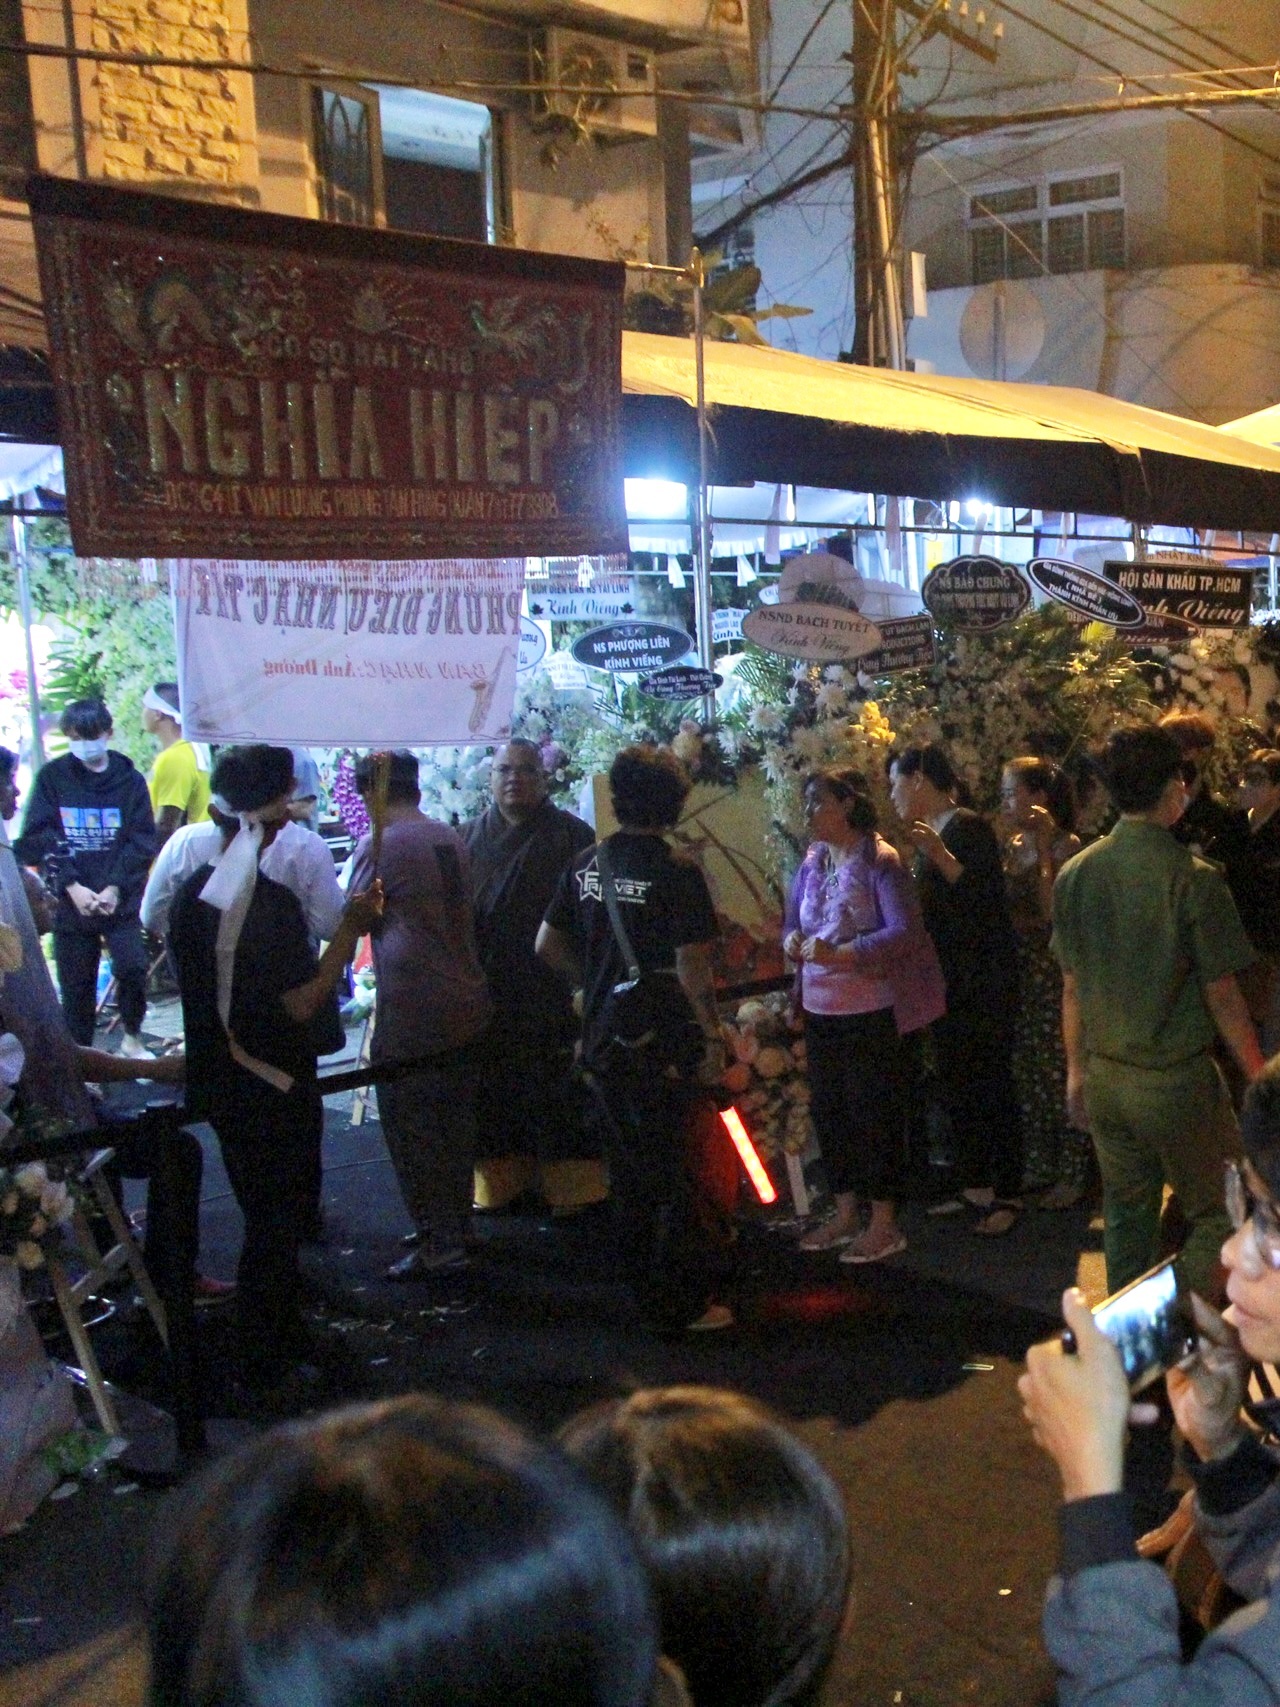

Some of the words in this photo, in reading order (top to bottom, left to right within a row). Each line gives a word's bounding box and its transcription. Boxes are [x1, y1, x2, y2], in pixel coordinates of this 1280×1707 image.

[593, 643, 607, 654] NS
[608, 638, 649, 656] PHƯỢNG
[650, 635, 671, 649] LIÊN
[604, 656, 631, 670] KÍNH
[632, 653, 663, 667] VIẾNG
